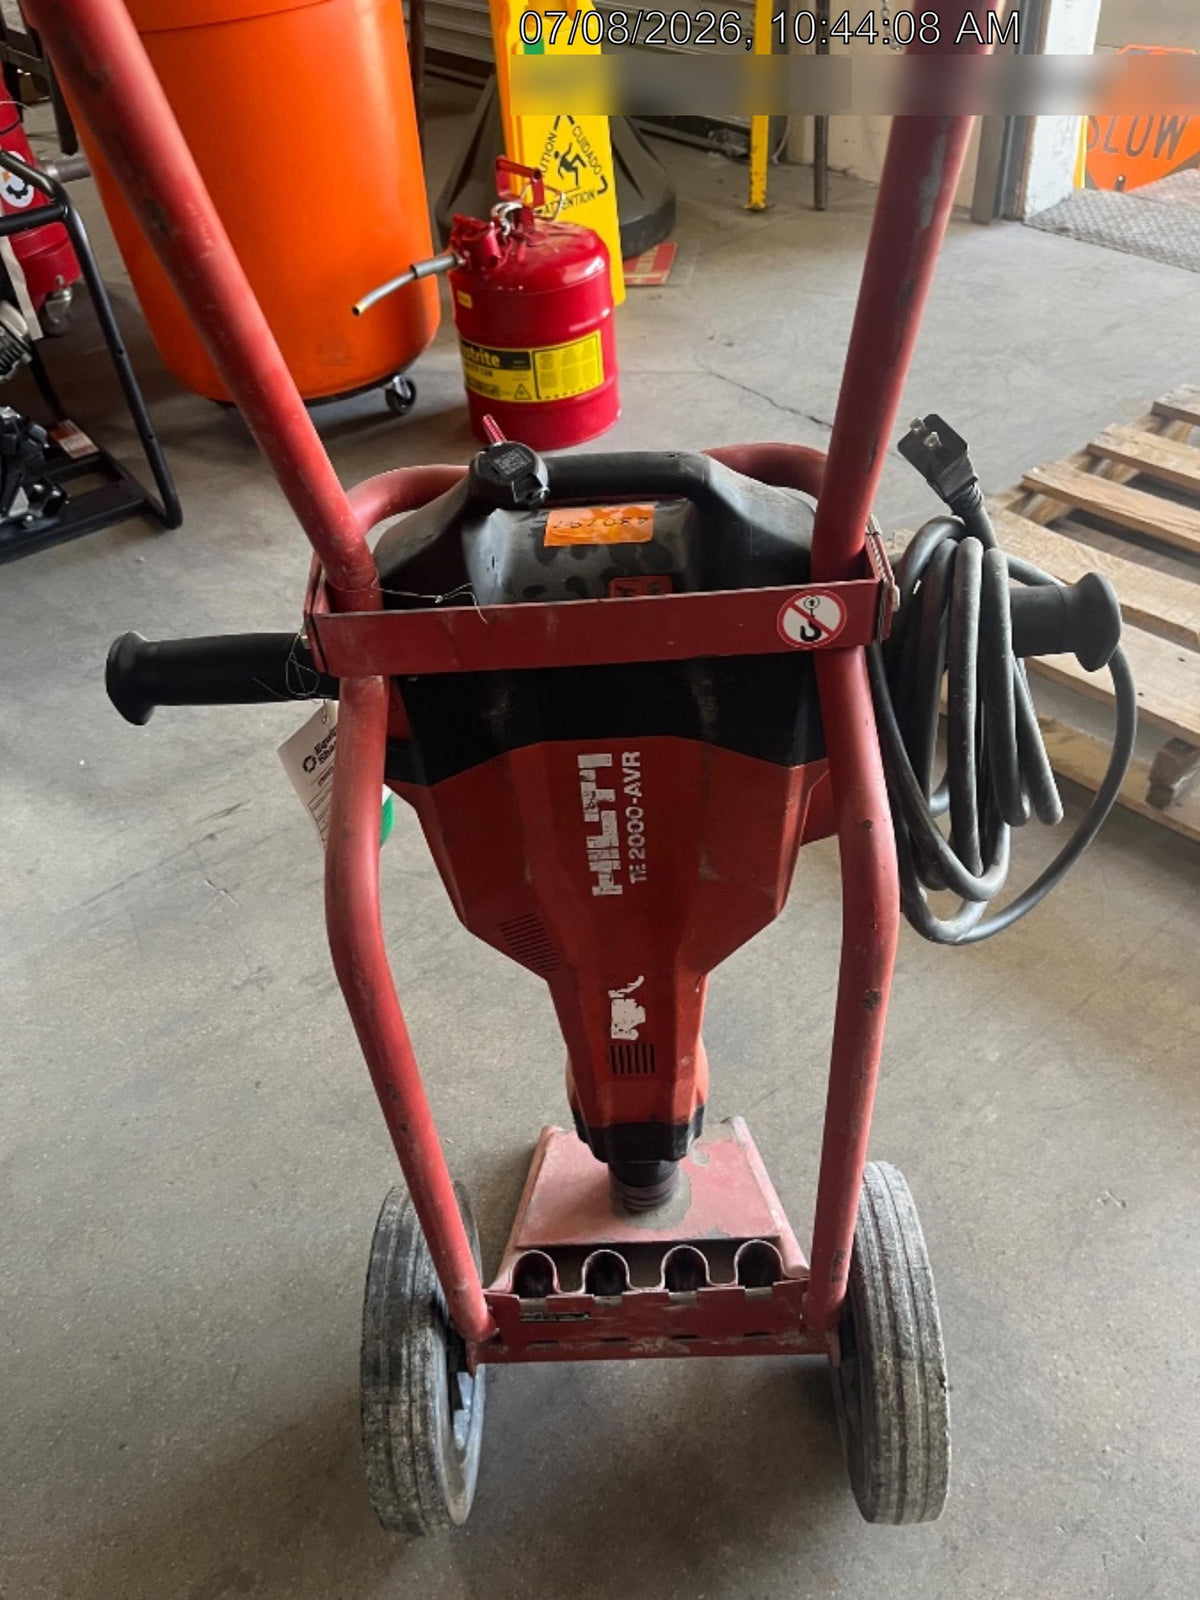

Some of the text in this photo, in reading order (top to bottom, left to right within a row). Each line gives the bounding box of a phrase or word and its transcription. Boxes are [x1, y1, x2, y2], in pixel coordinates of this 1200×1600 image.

[540, 132, 557, 173] UTION
[572, 126, 602, 175] CUIDADO
[578, 753, 623, 896] HILTI
[621, 751, 645, 860] 2000-AVR
